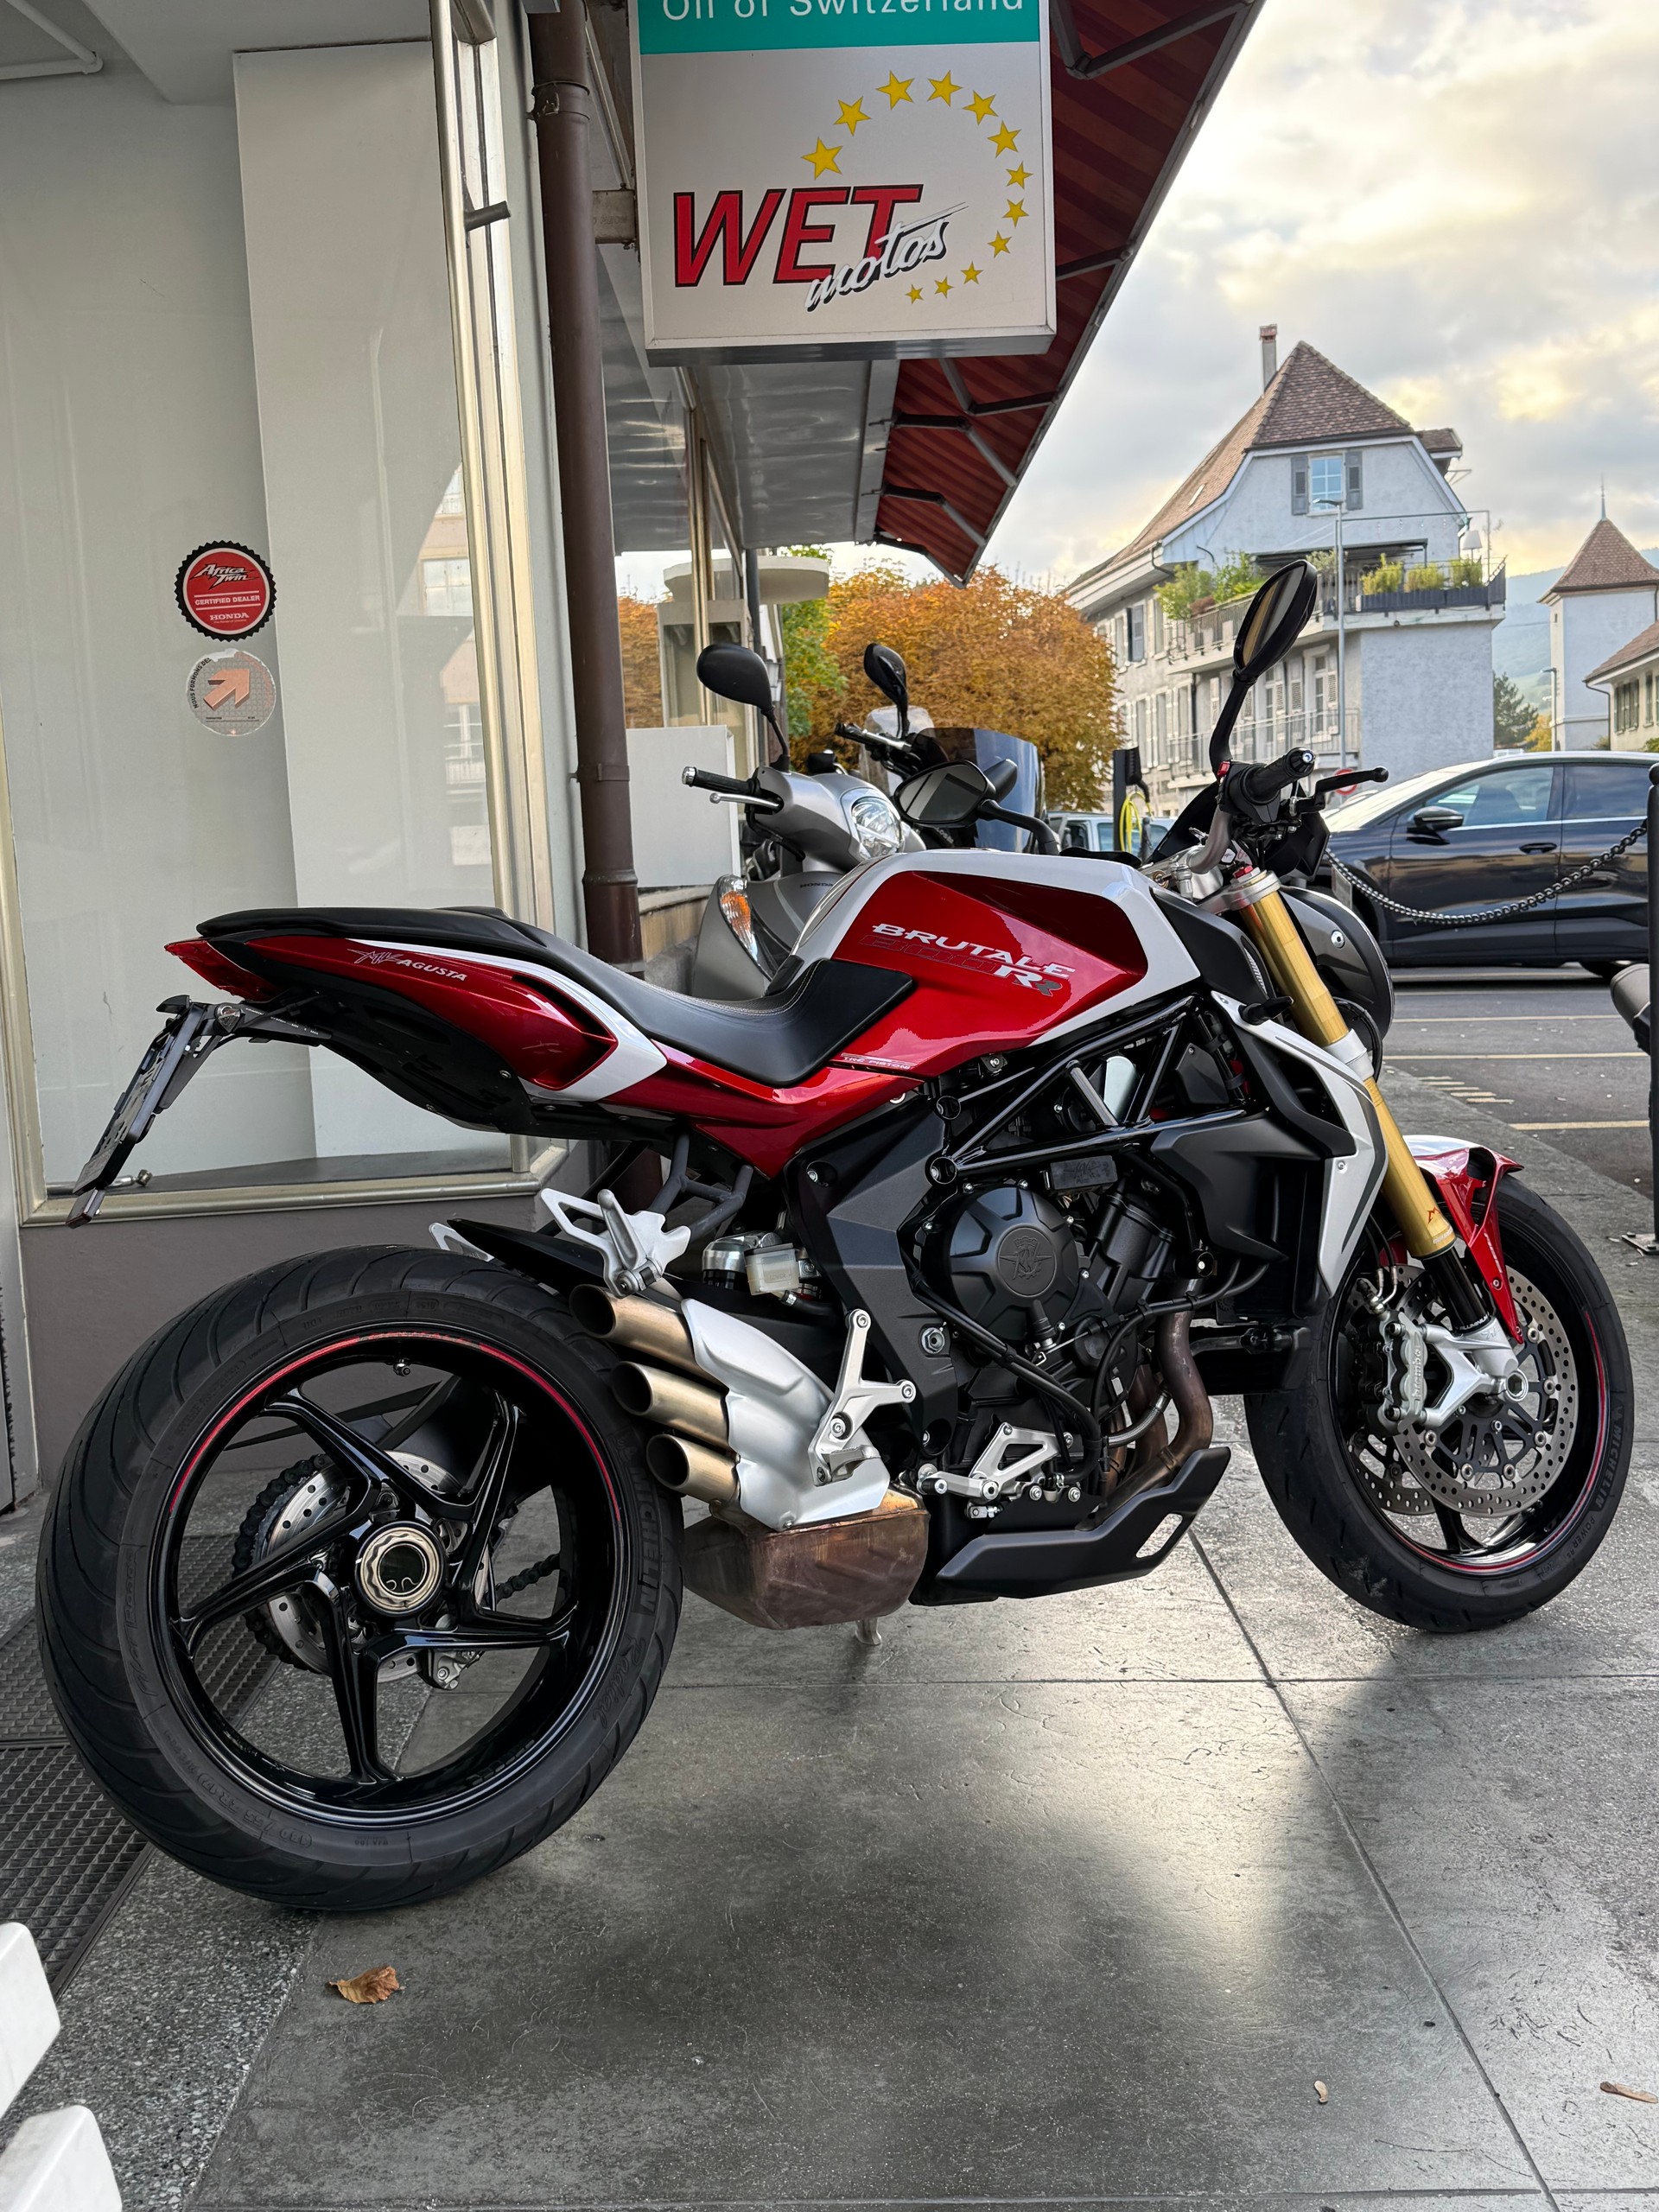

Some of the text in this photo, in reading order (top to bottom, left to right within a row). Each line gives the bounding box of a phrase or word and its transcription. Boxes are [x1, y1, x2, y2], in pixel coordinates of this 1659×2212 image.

[663, 0, 714, 21] Oil
[673, 183, 924, 287] WET
[804, 202, 969, 312] motos
[192, 563, 251, 578] Africa
[211, 573, 252, 588] Twin
[209, 613, 250, 621] HONDA
[189, 664, 203, 691] FORMONS
[189, 692, 200, 709] NOUS
[872, 923, 1076, 978] BRUTALE
[396, 958, 468, 982] AGUSTA
[1412, 1349, 1421, 1400] brembo
[1595, 1426, 1623, 1509] MICHELIN
[629, 1466, 659, 1612] MICHELIN
[1573, 1516, 1596, 1548] POWER
[593, 1635, 647, 1728] Radial
